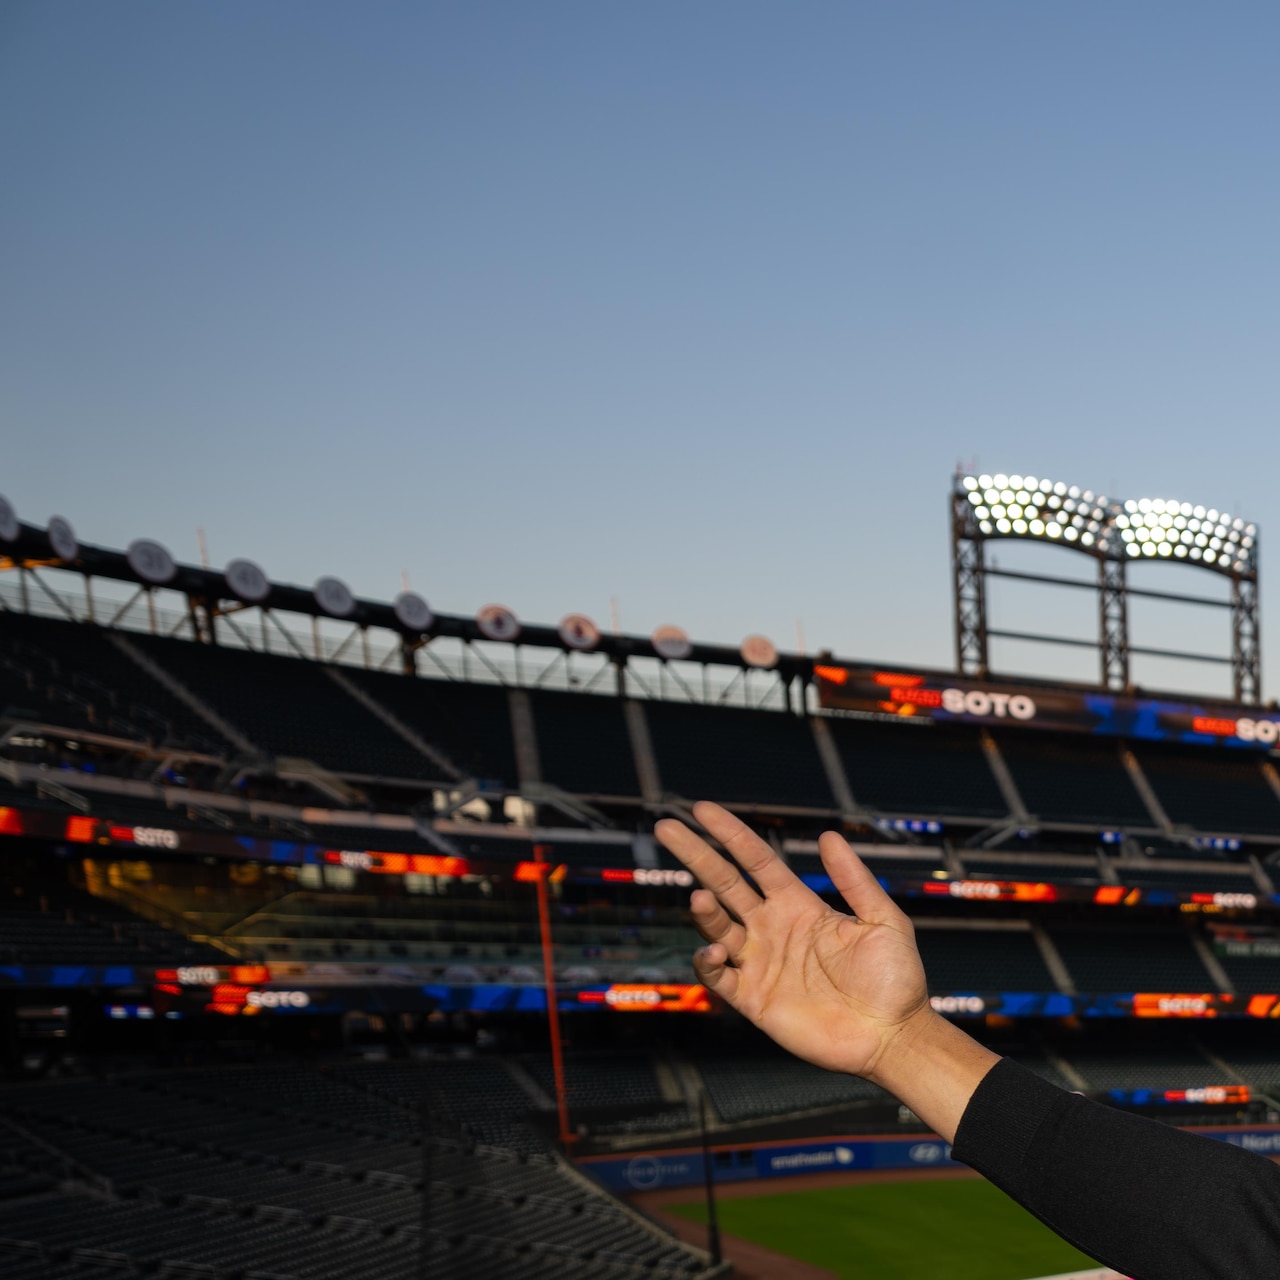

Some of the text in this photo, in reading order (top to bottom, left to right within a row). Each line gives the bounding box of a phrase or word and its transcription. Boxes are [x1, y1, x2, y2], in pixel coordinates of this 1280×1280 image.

[942, 689, 1035, 719] SOTO
[633, 868, 693, 886] SOTO
[949, 881, 1000, 898] SOTO
[1213, 893, 1256, 908] SOTO
[177, 967, 218, 984] SOTO
[247, 991, 309, 1007] SOTO
[605, 988, 660, 1004] SOTO
[930, 997, 984, 1012] SOTO
[1159, 999, 1206, 1013] SOTO
